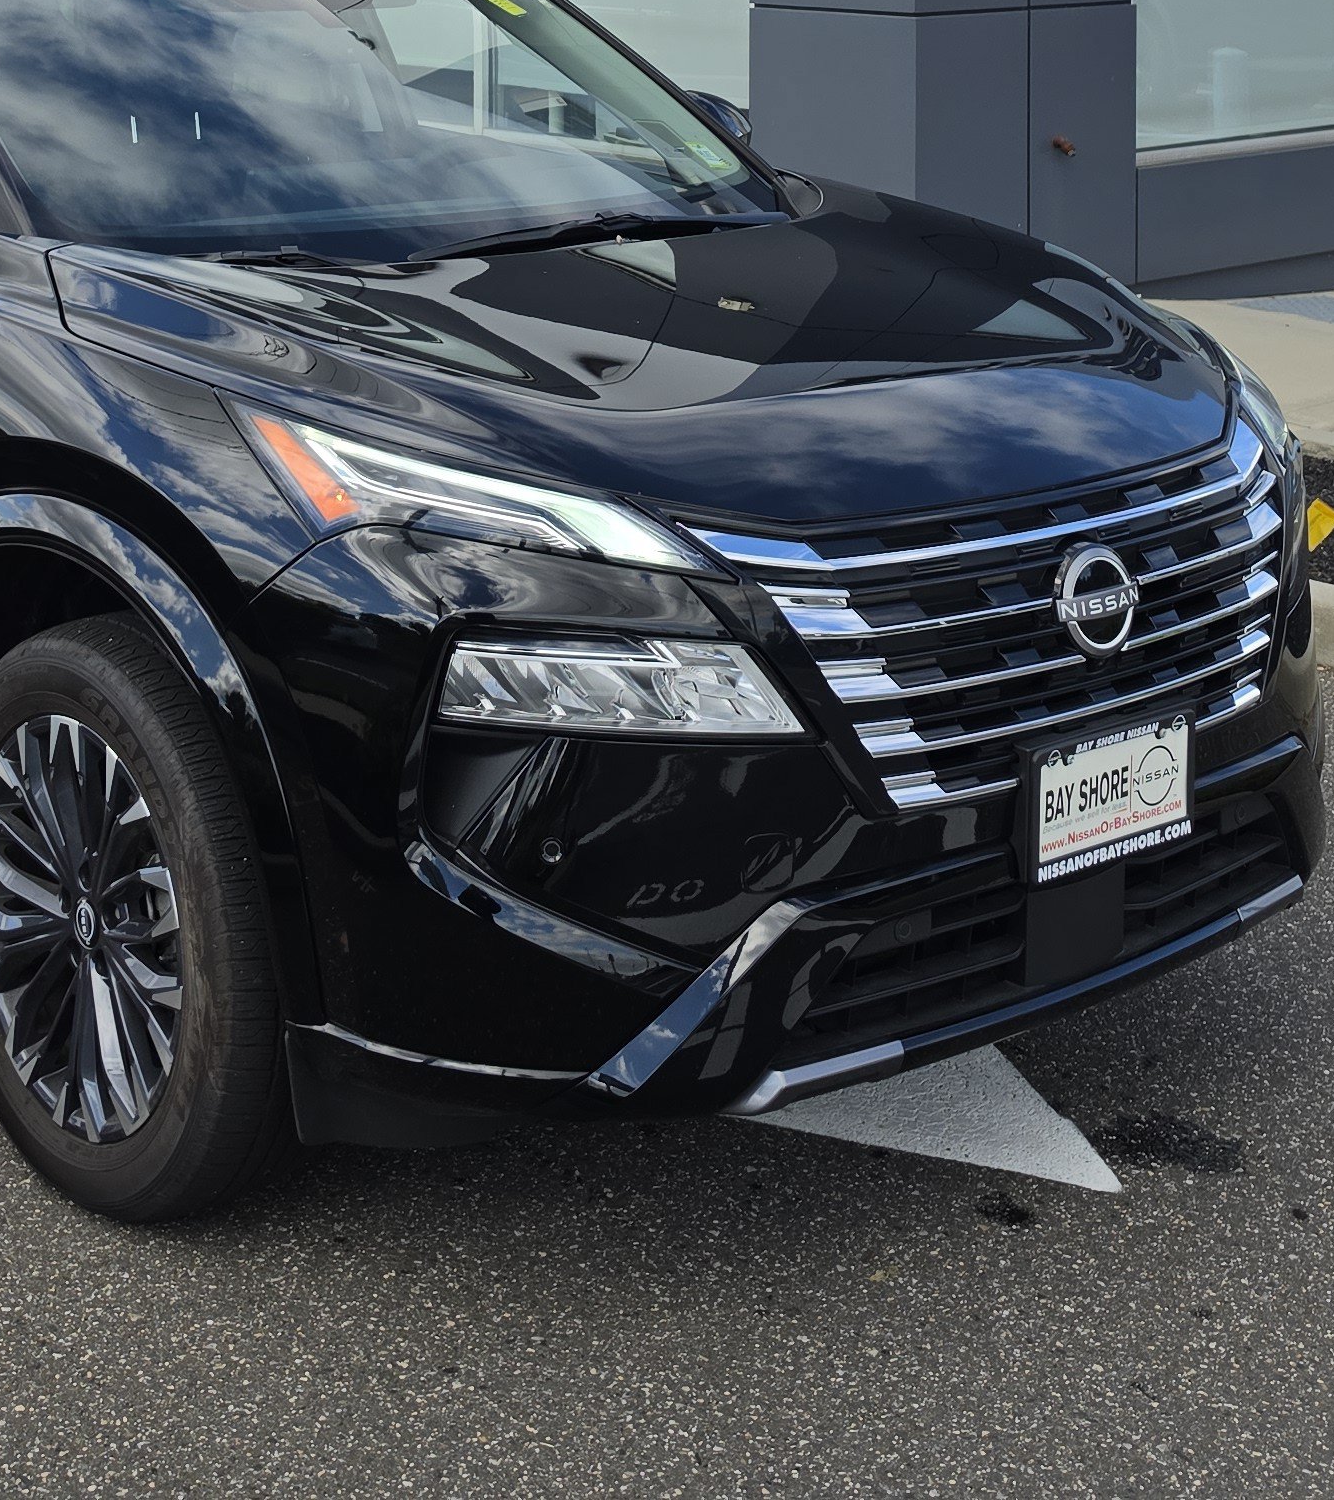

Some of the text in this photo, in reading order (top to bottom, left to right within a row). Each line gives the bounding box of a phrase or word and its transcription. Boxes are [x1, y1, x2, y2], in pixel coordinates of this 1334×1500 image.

[1060, 585, 1139, 619] NISSAN
[1075, 721, 1160, 754] BAY SHORE NISSAN
[1133, 764, 1179, 787] NISSAN
[1044, 766, 1129, 824] BAY SHORE
[1042, 819, 1073, 835] Because
[1037, 819, 1192, 883] NISSANOFBAYSHORE.COM
